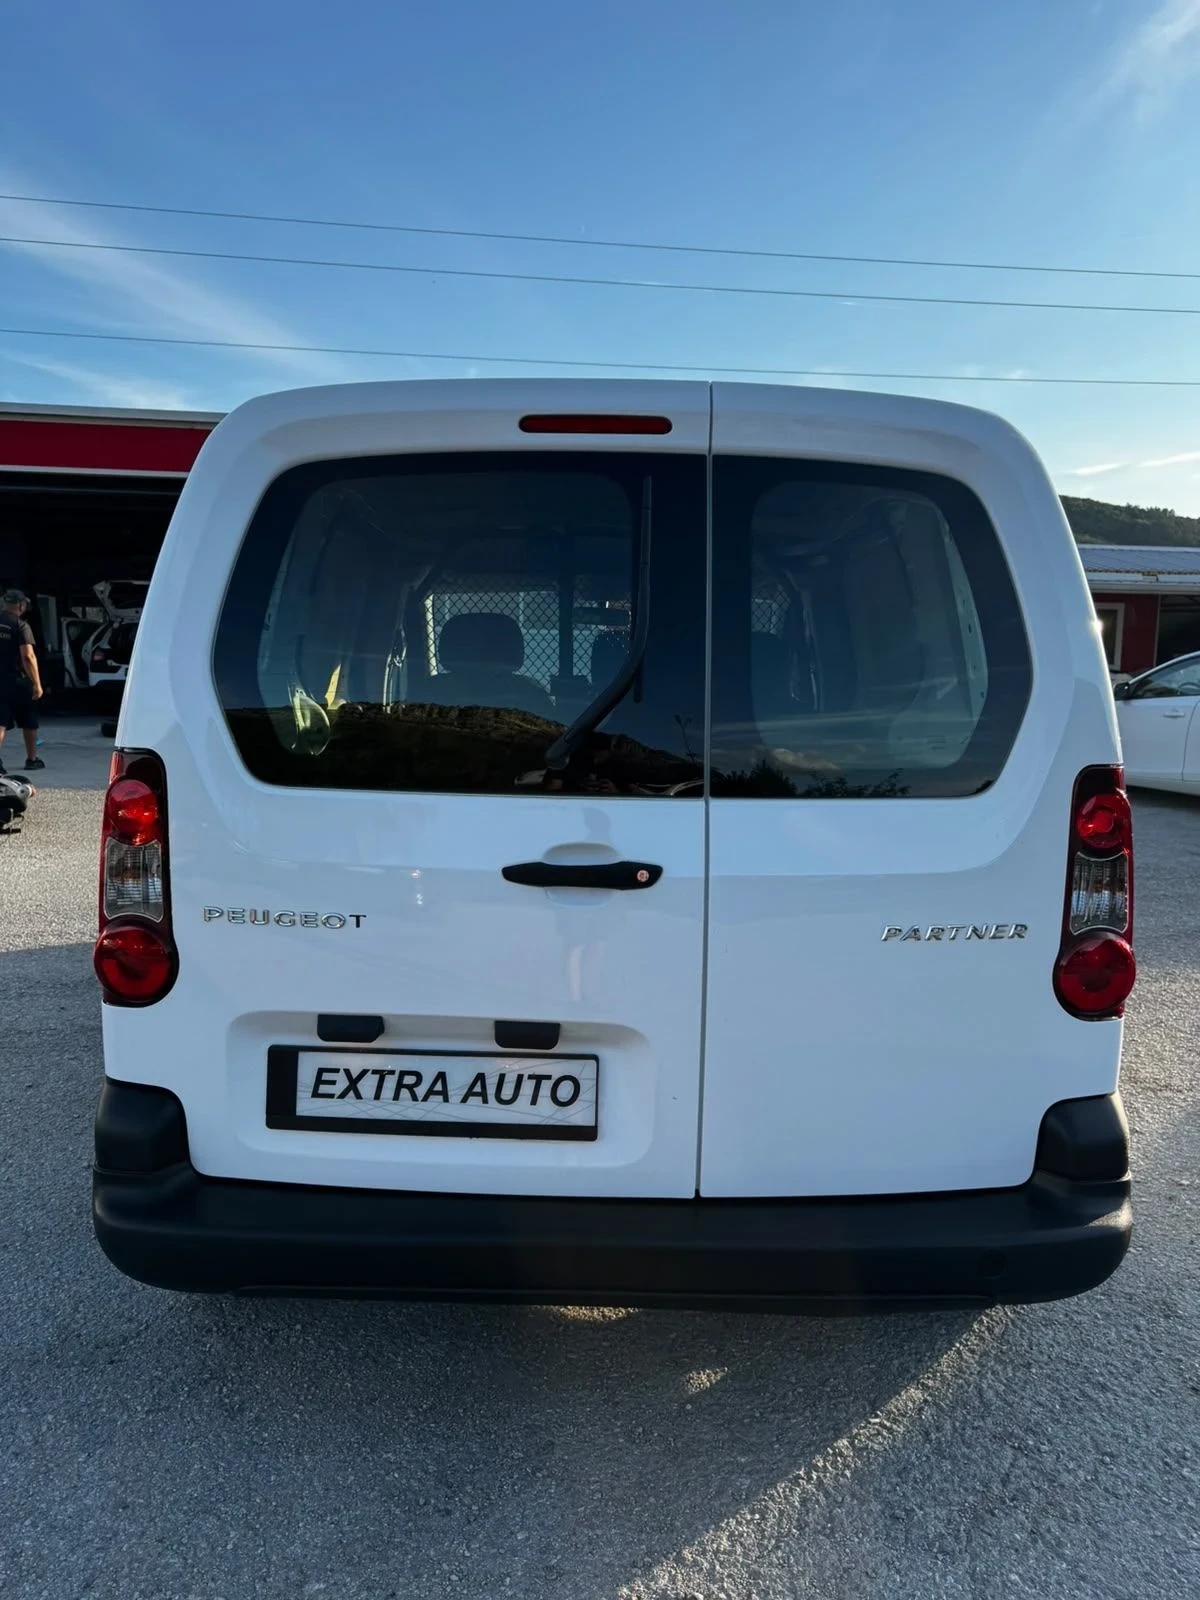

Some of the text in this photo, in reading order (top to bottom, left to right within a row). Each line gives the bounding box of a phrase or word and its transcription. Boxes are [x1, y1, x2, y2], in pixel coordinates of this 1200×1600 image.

[203, 905, 367, 929] PEUGEOT
[881, 923, 1028, 941] PARTNER
[310, 1067, 581, 1108] EXTRA AUTO
